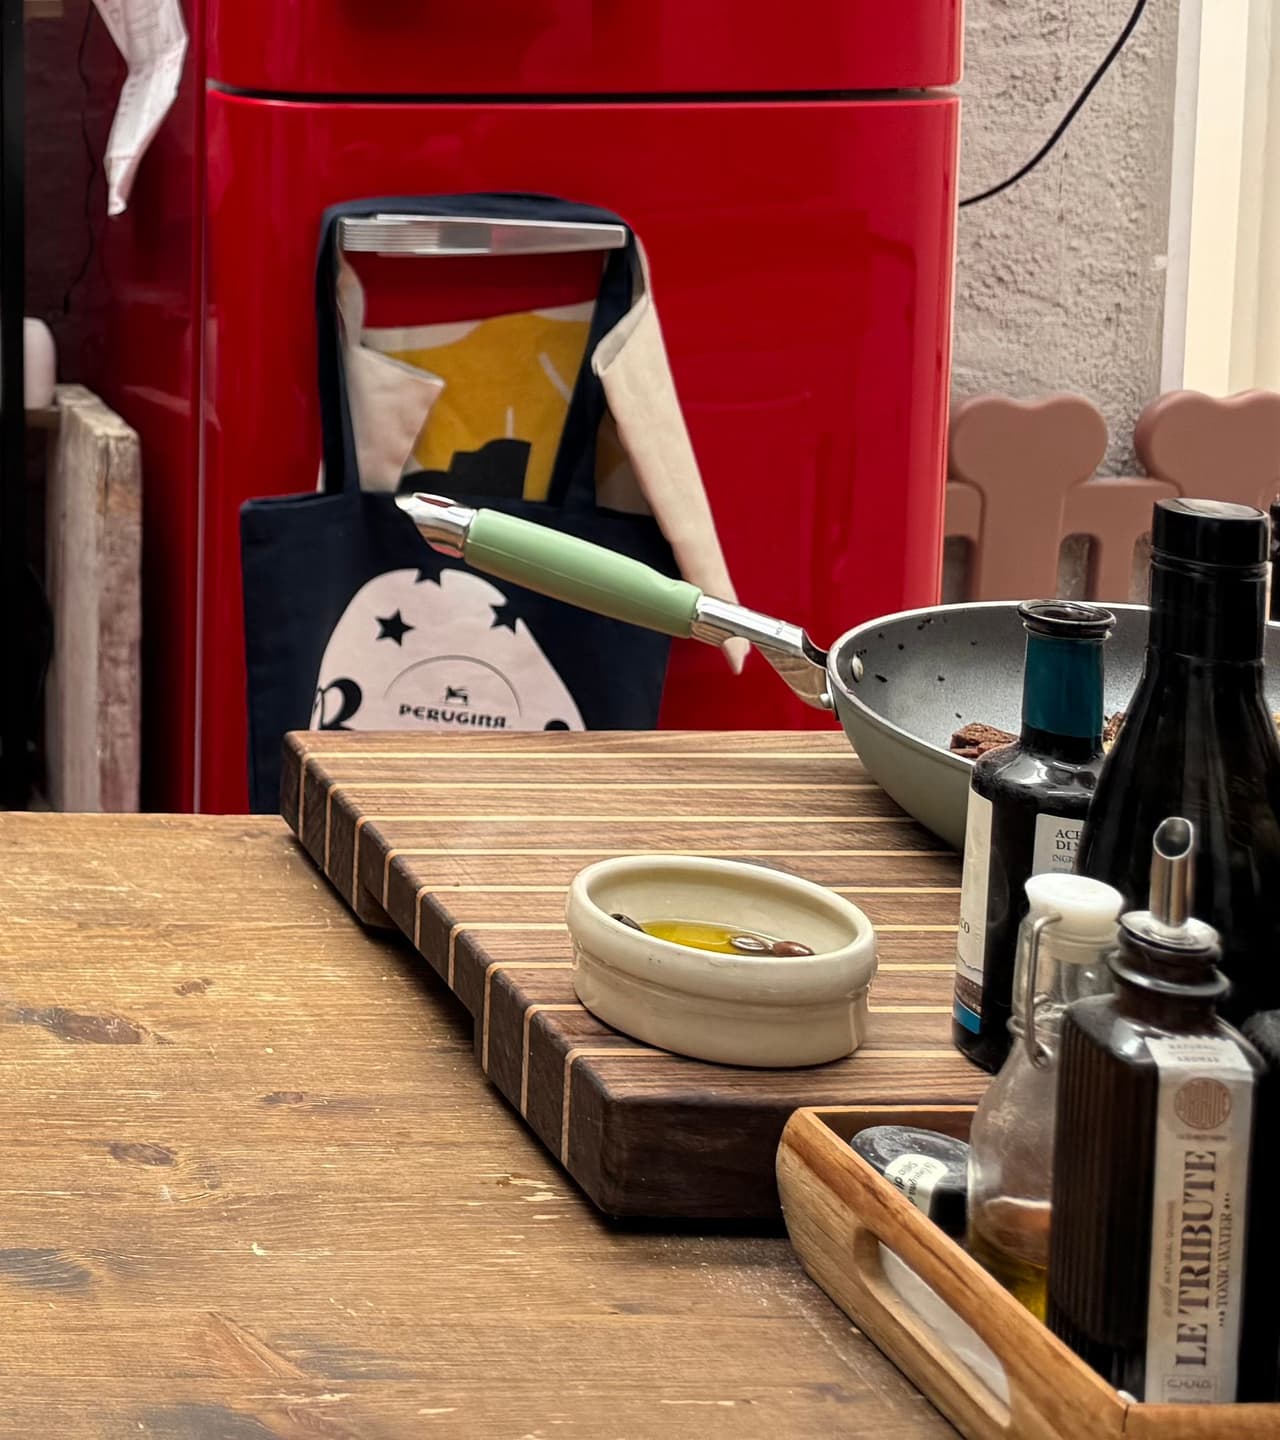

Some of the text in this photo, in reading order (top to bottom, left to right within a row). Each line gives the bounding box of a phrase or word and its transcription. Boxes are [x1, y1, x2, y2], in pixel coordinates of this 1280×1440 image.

[398, 703, 508, 729] PERUGINA
[1178, 1150, 1217, 1317] TRIBUTE
[1216, 1212, 1233, 1309] TONIC WATER
[1176, 1323, 1208, 1367] LE
